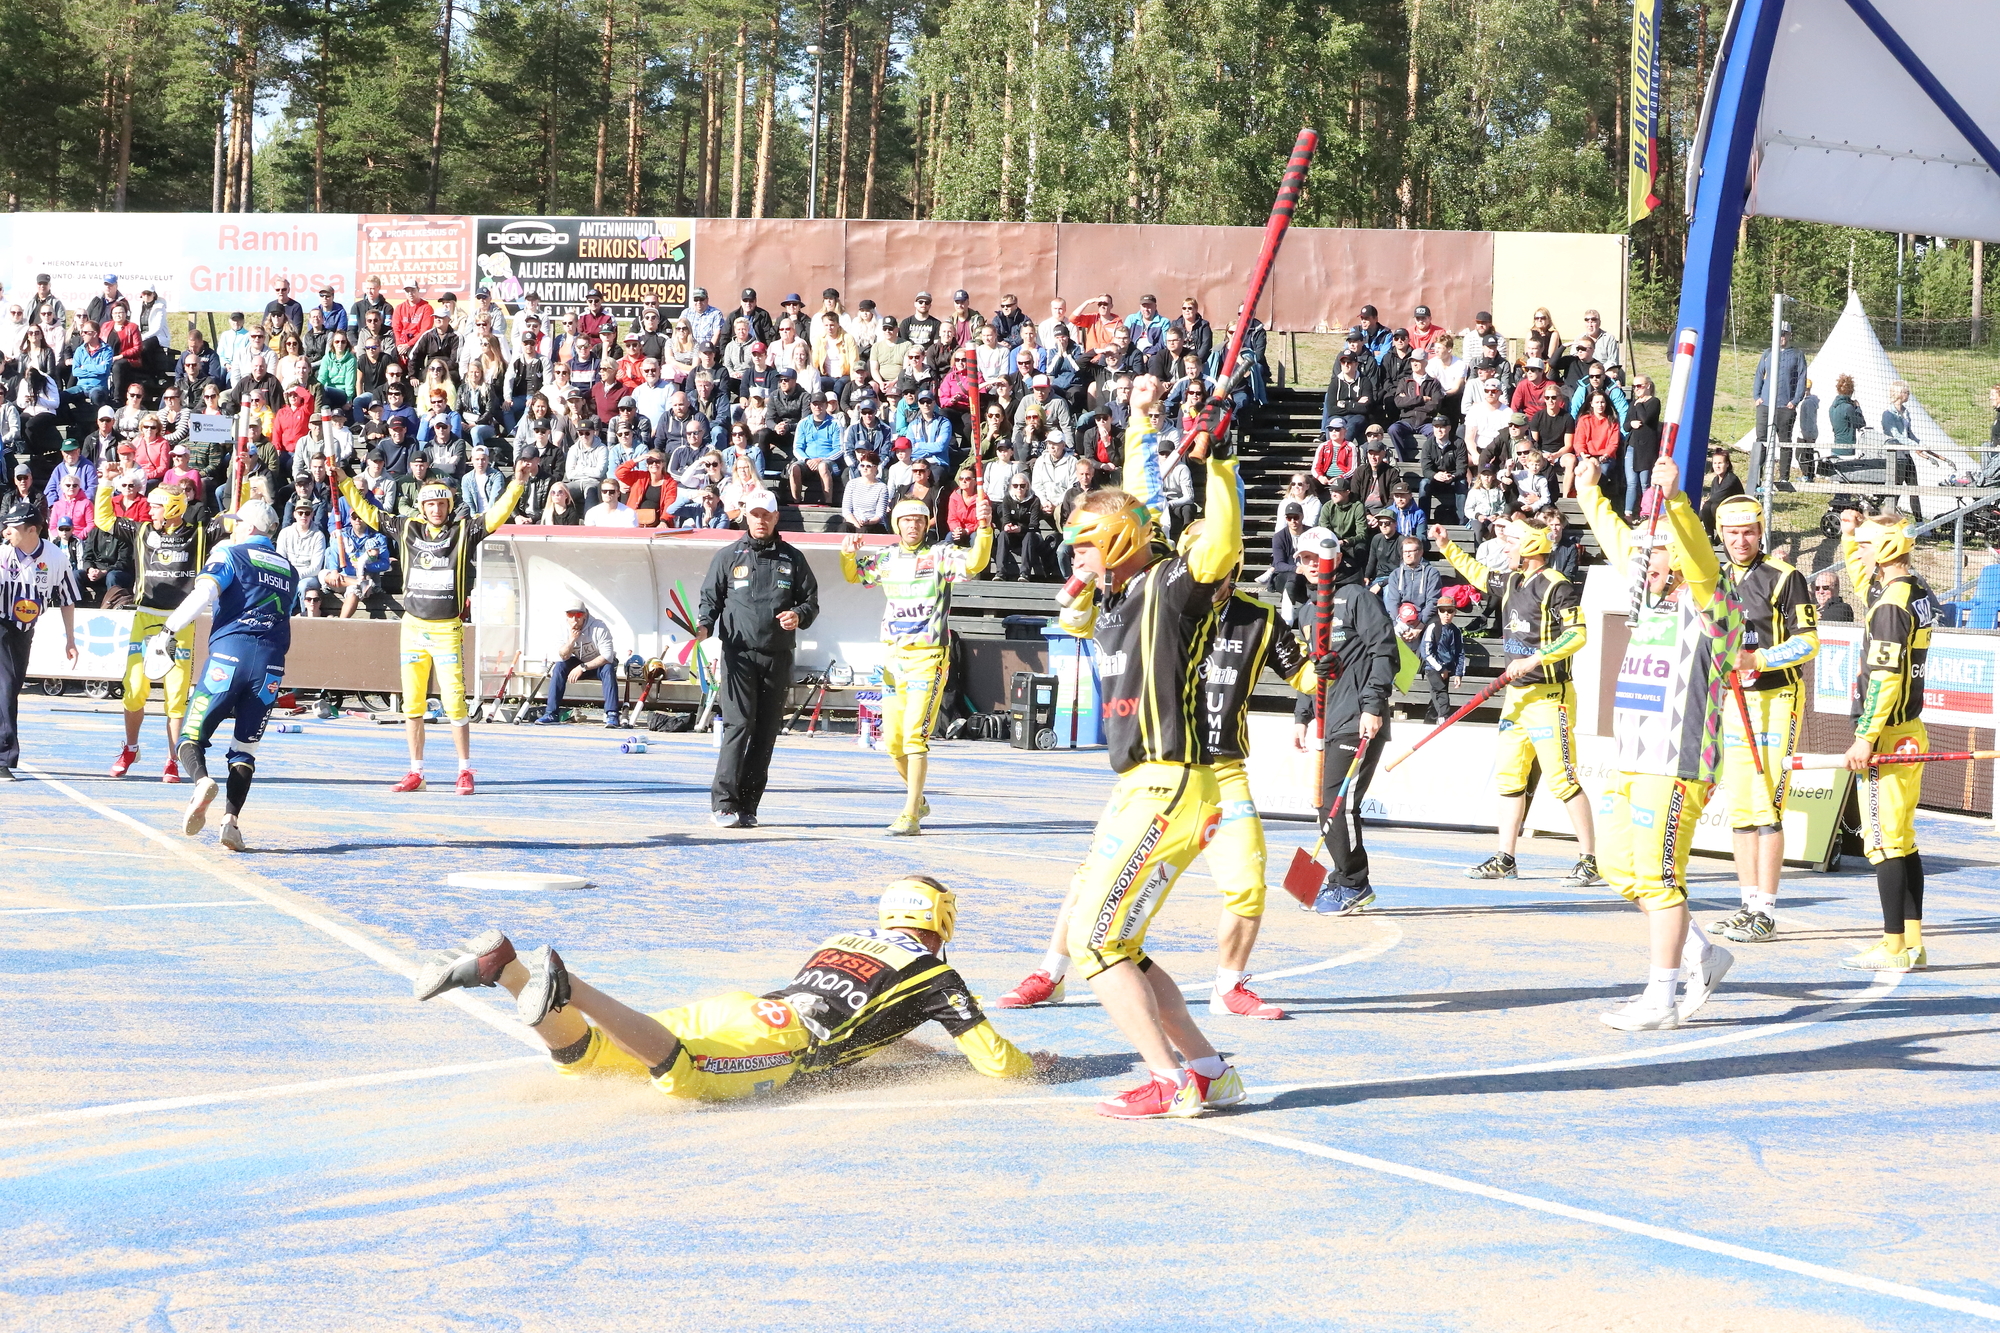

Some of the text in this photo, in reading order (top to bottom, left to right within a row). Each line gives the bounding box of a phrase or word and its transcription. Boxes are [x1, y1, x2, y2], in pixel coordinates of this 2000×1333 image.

[1633, 11, 1650, 173] BLÅKLÄDER
[218, 224, 319, 252] Ramin
[386, 228, 459, 238] PROFIILIKESKUS OY
[578, 222, 677, 237] ANTENNIHUOLLON
[368, 240, 458, 260] KAIKKI
[578, 238, 676, 259] ERIKOISLIIKE
[368, 260, 459, 272] MITÄ KATTOSI
[518, 262, 686, 281] ALUEEN ANTENNIT HUOLTAA
[523, 282, 589, 302] MARTIMO
[207, 562, 216, 572] 1
[258, 571, 290, 593] LASSILA
[883, 580, 934, 598] UBWAY
[1567, 607, 1578, 624] 7
[1804, 603, 1816, 627] 9
[1876, 641, 1891, 666] 5
[1820, 648, 1847, 692] K
[1925, 656, 1988, 686] ARKET
[1148, 785, 1173, 795] HT
[1091, 823, 1162, 945] HELAAKOSKI.COM
